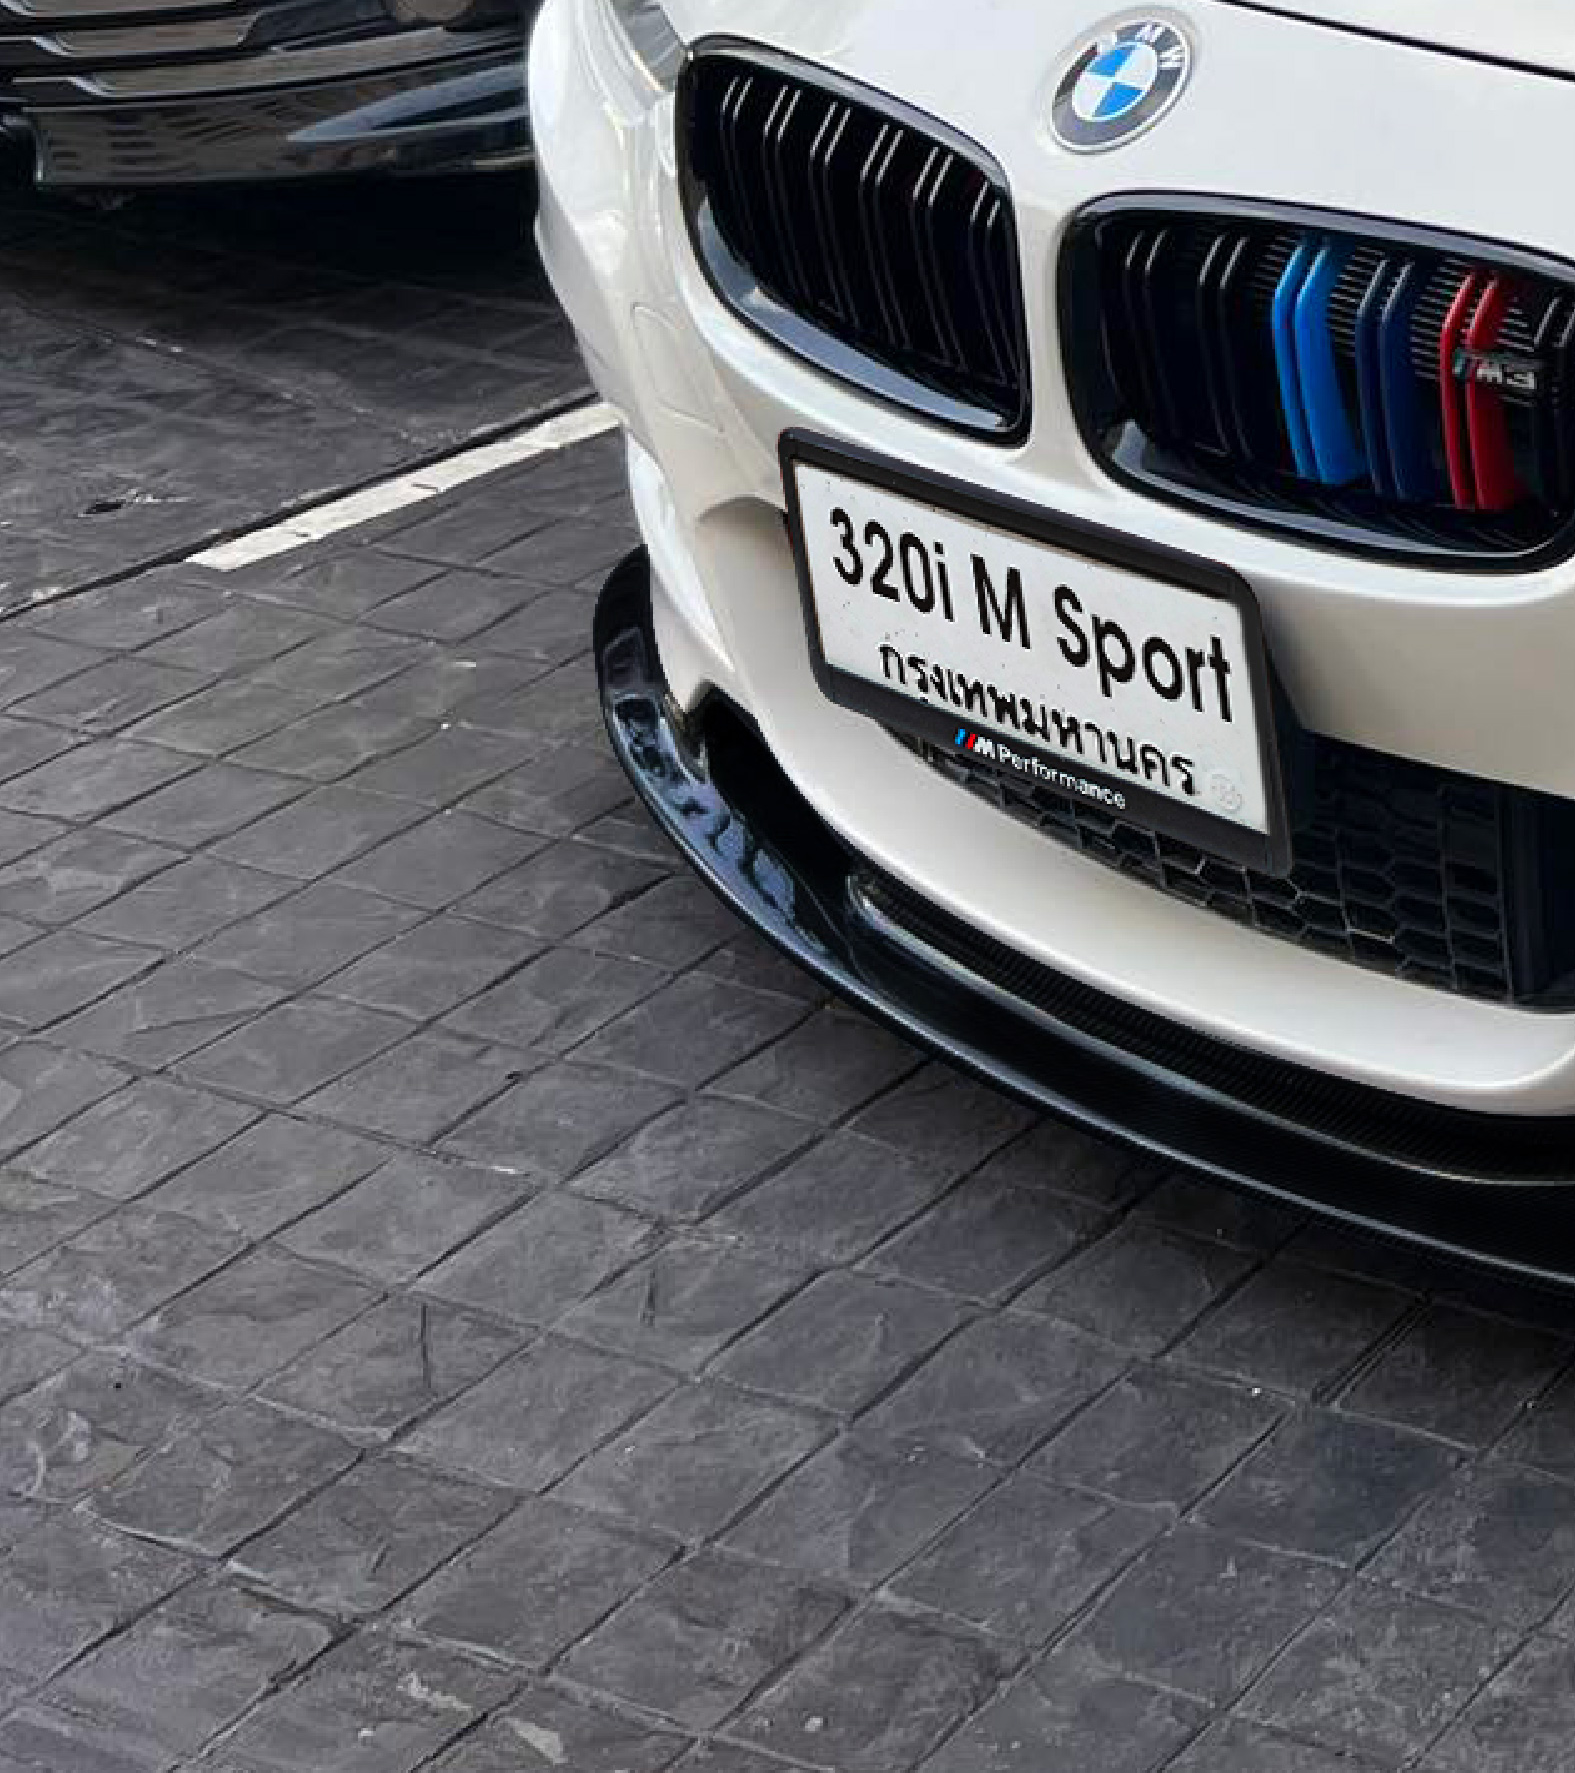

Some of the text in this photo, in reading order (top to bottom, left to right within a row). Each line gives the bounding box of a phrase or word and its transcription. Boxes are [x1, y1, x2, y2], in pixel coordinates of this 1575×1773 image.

[830, 507, 1233, 723] 320i M Sport
[878, 643, 1196, 796] กรุงเทพมหานคร
